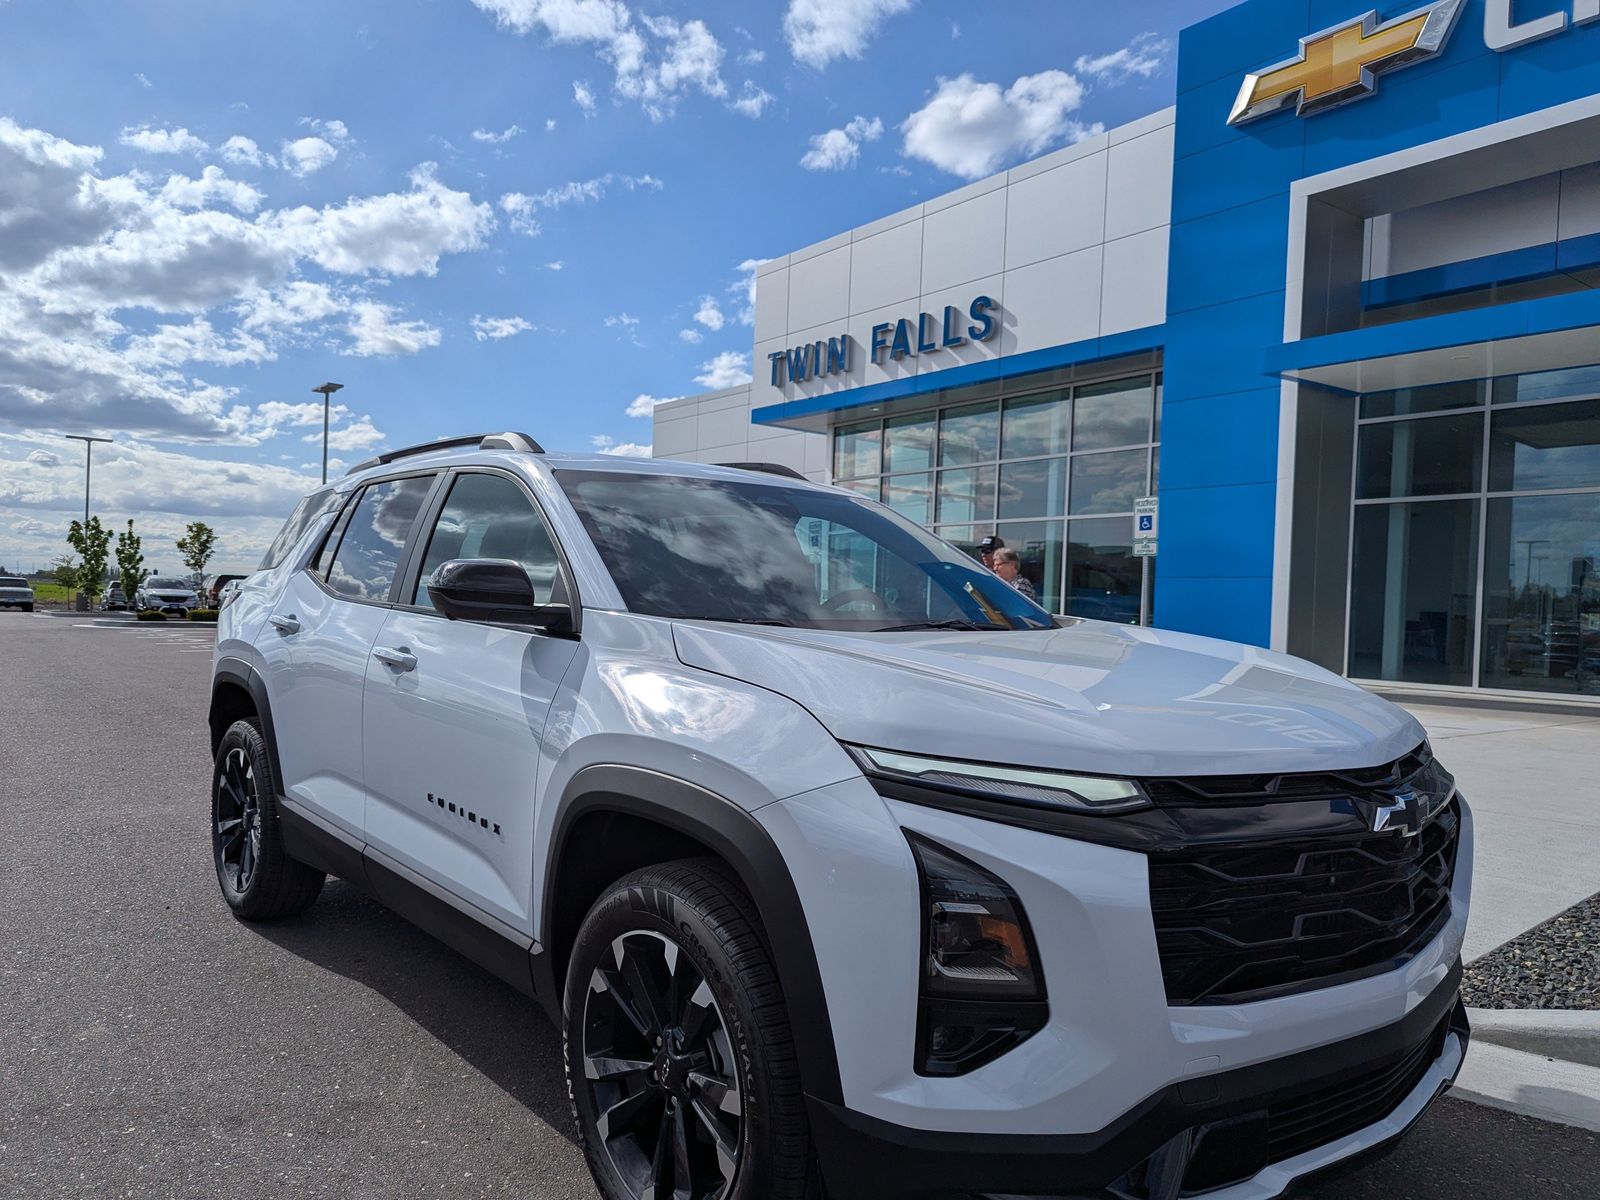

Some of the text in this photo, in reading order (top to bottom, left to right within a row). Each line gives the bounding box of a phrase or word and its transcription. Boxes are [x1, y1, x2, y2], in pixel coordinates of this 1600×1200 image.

[768, 295, 998, 387] TWIN FALLS
[427, 792, 501, 836] EQUINOX
